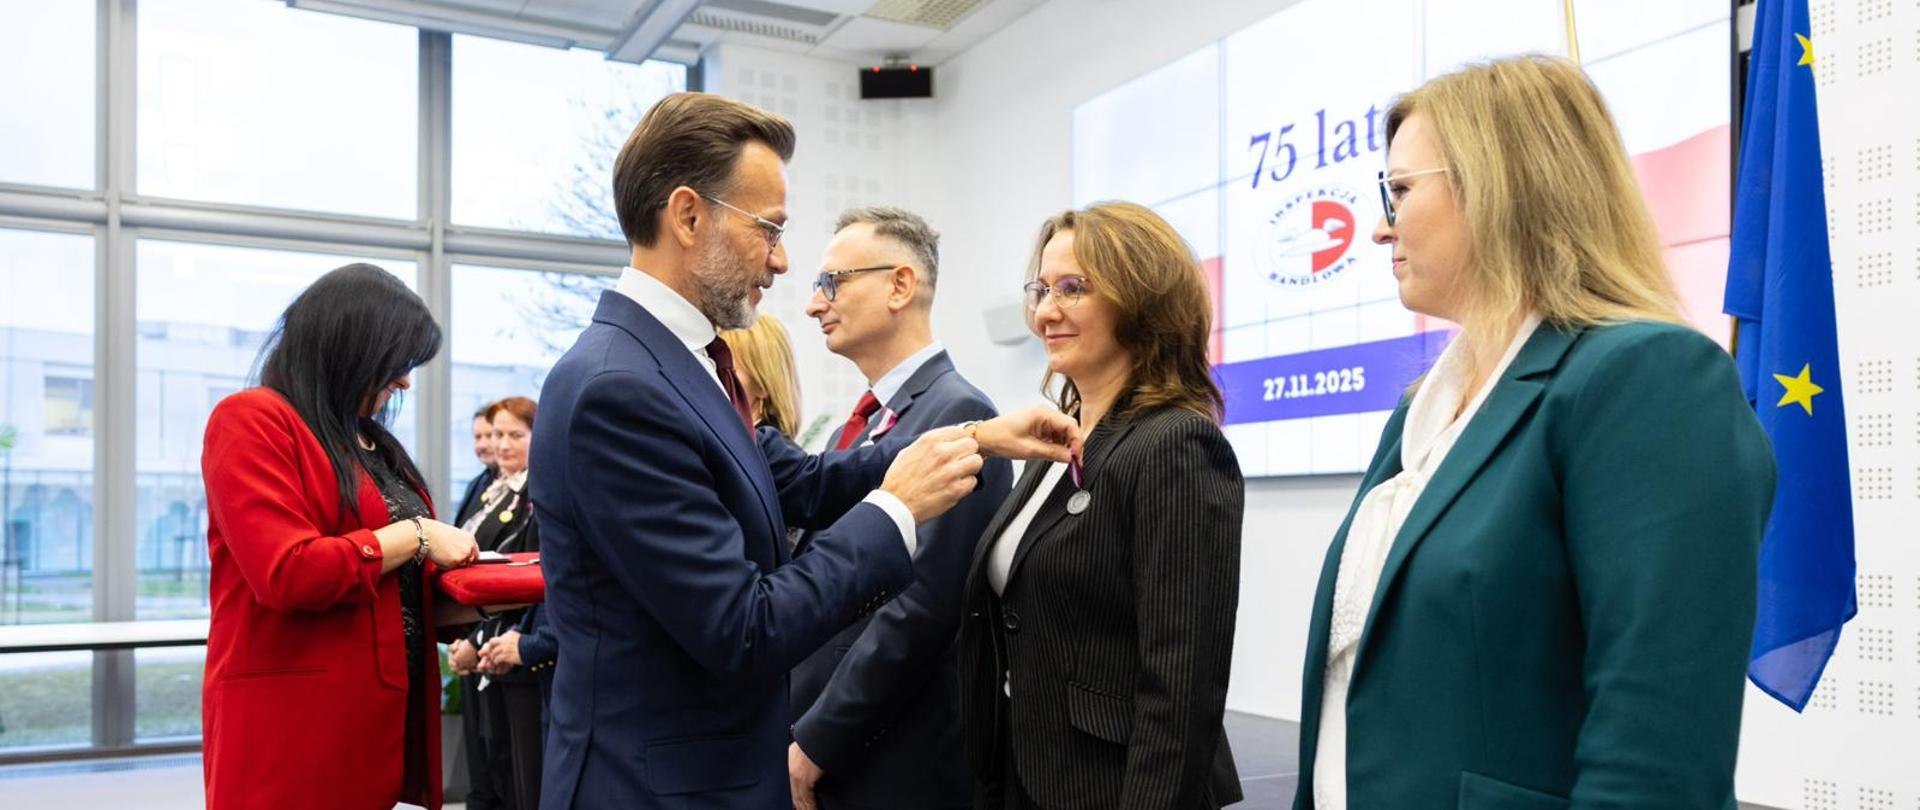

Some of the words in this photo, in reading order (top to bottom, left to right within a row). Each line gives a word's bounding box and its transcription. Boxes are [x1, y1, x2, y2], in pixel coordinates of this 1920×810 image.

[1249, 123, 1296, 189] 75
[1314, 104, 1380, 169] lat
[1263, 366, 1365, 401] 27.11.2025
